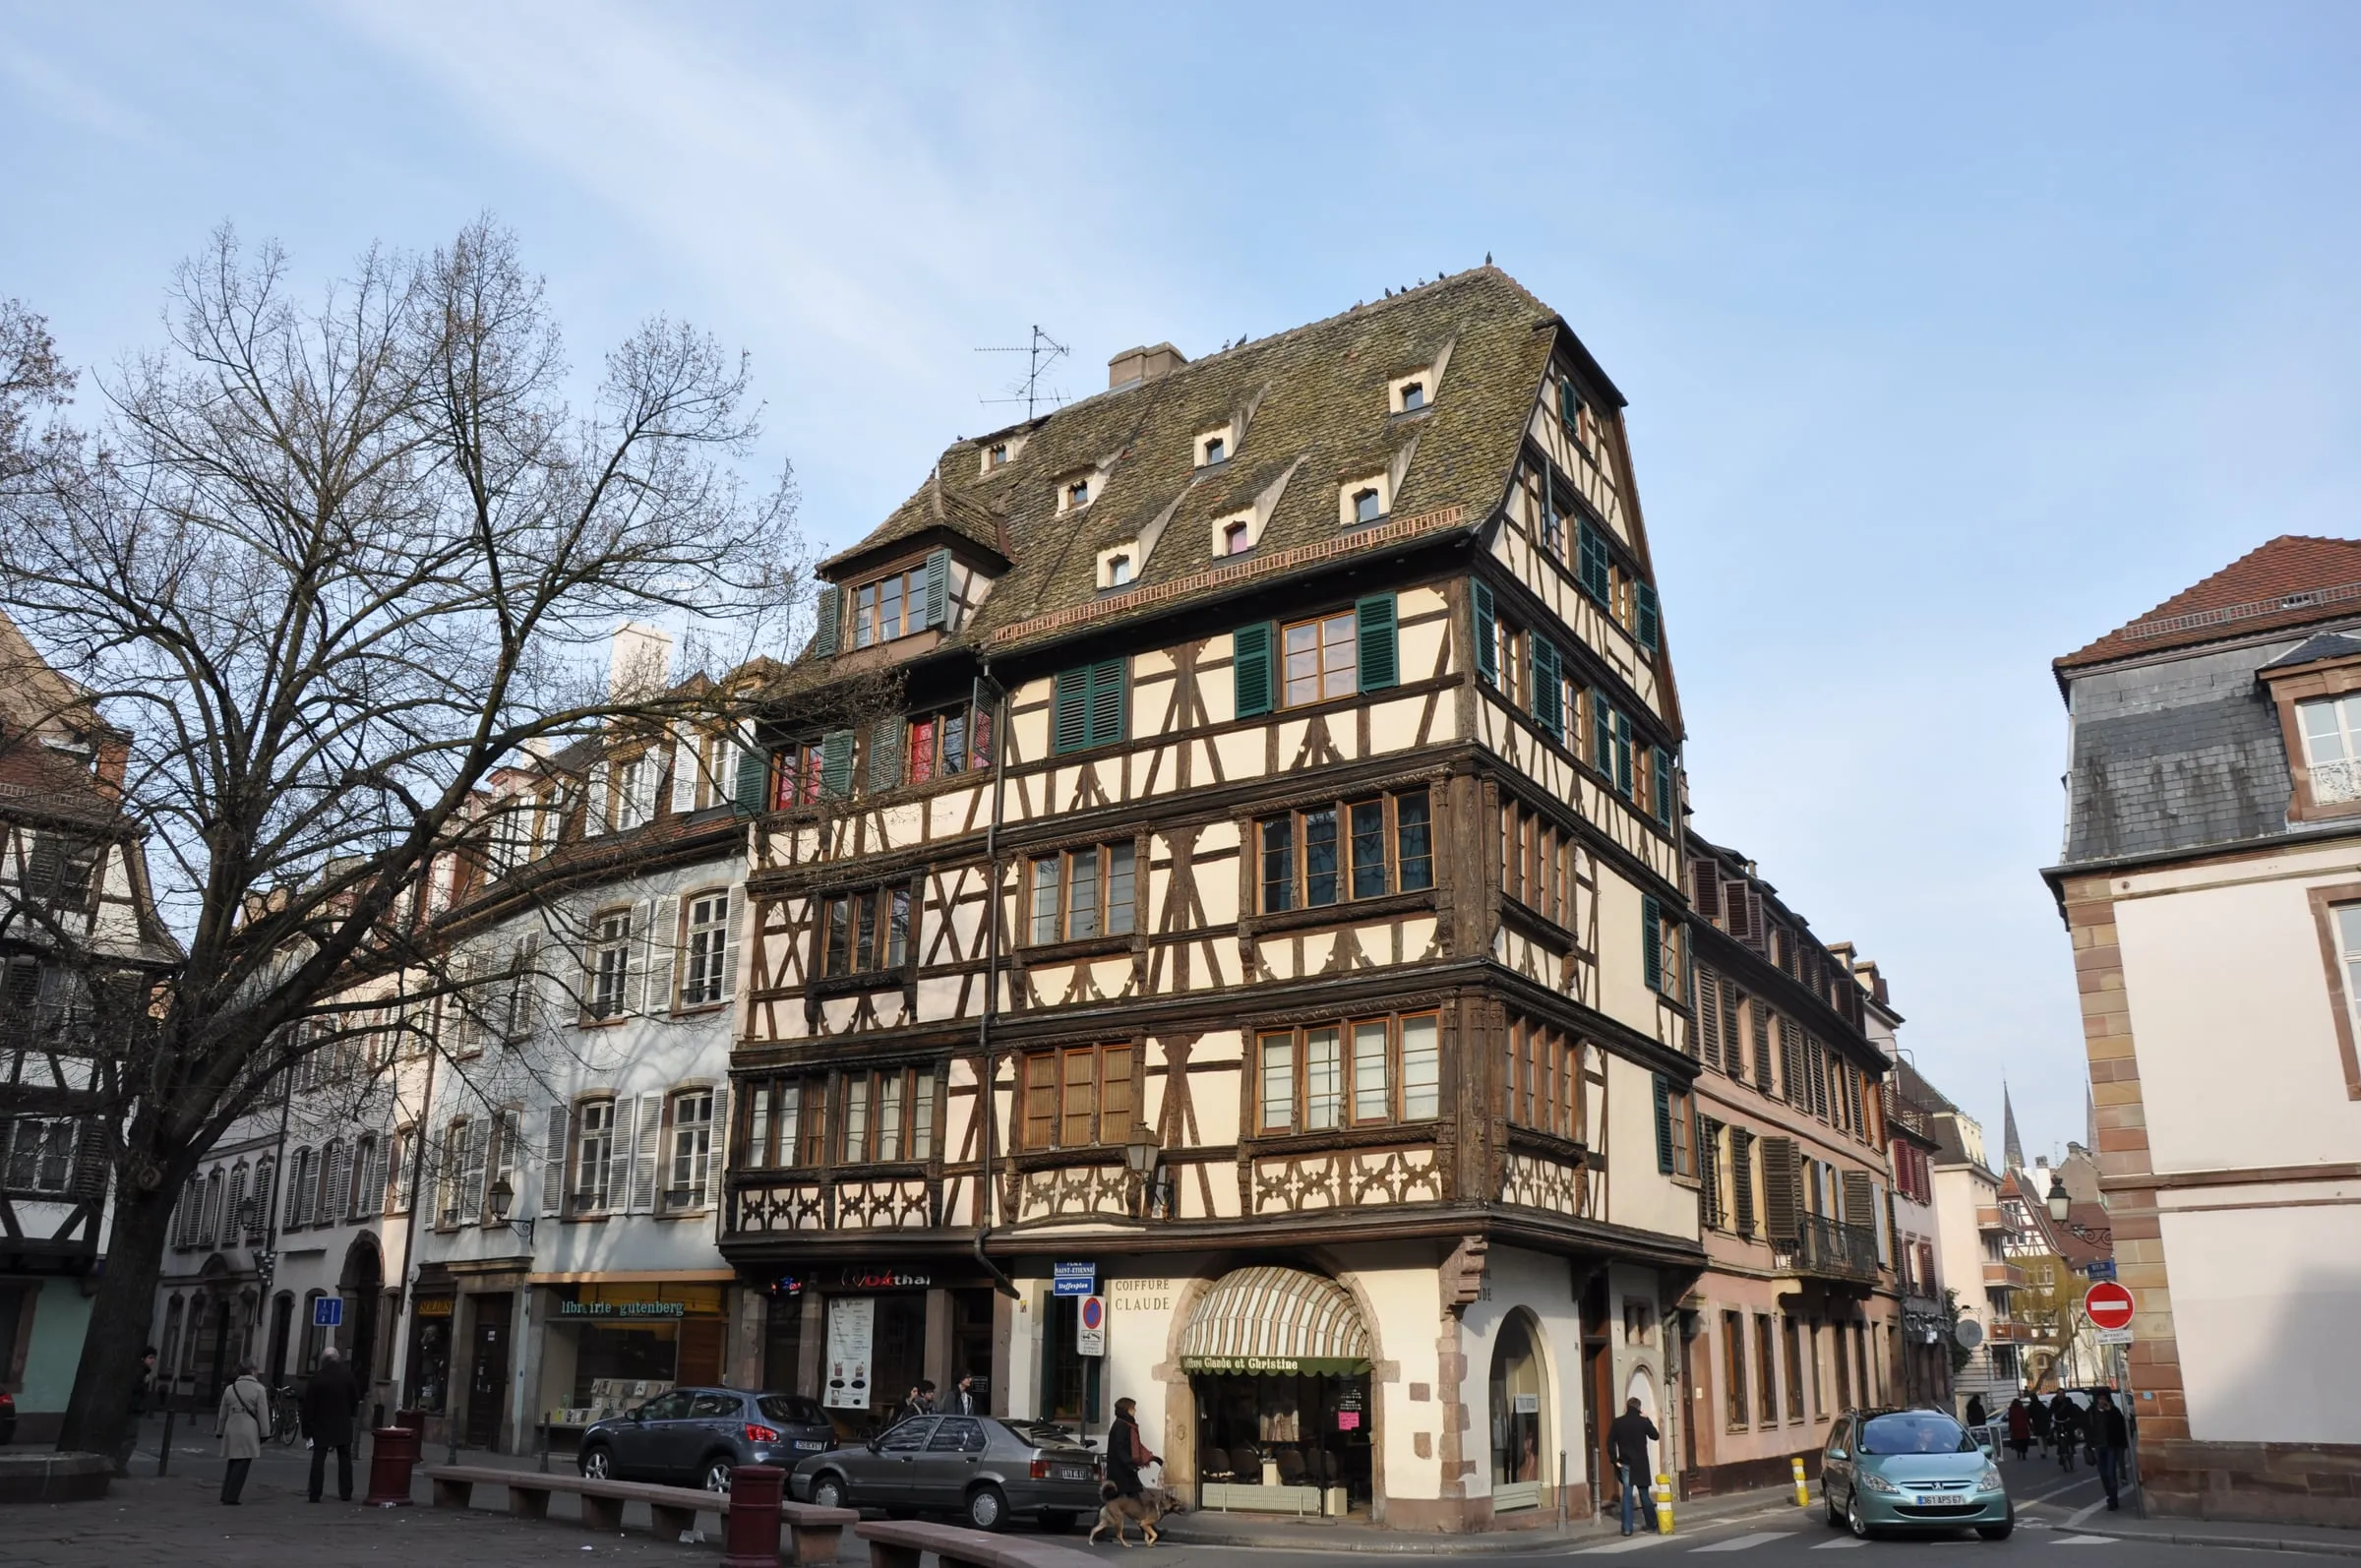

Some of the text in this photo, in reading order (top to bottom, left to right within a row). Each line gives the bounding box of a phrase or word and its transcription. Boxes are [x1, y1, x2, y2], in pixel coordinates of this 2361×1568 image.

[1116, 1280, 1170, 1291] COIFFURE
[620, 1301, 685, 1316] gutenberg
[1116, 1297, 1170, 1310] CLAUDE
[1204, 1357, 1232, 1368] Claude
[1235, 1358, 1245, 1368] et
[1248, 1358, 1298, 1369] Christine
